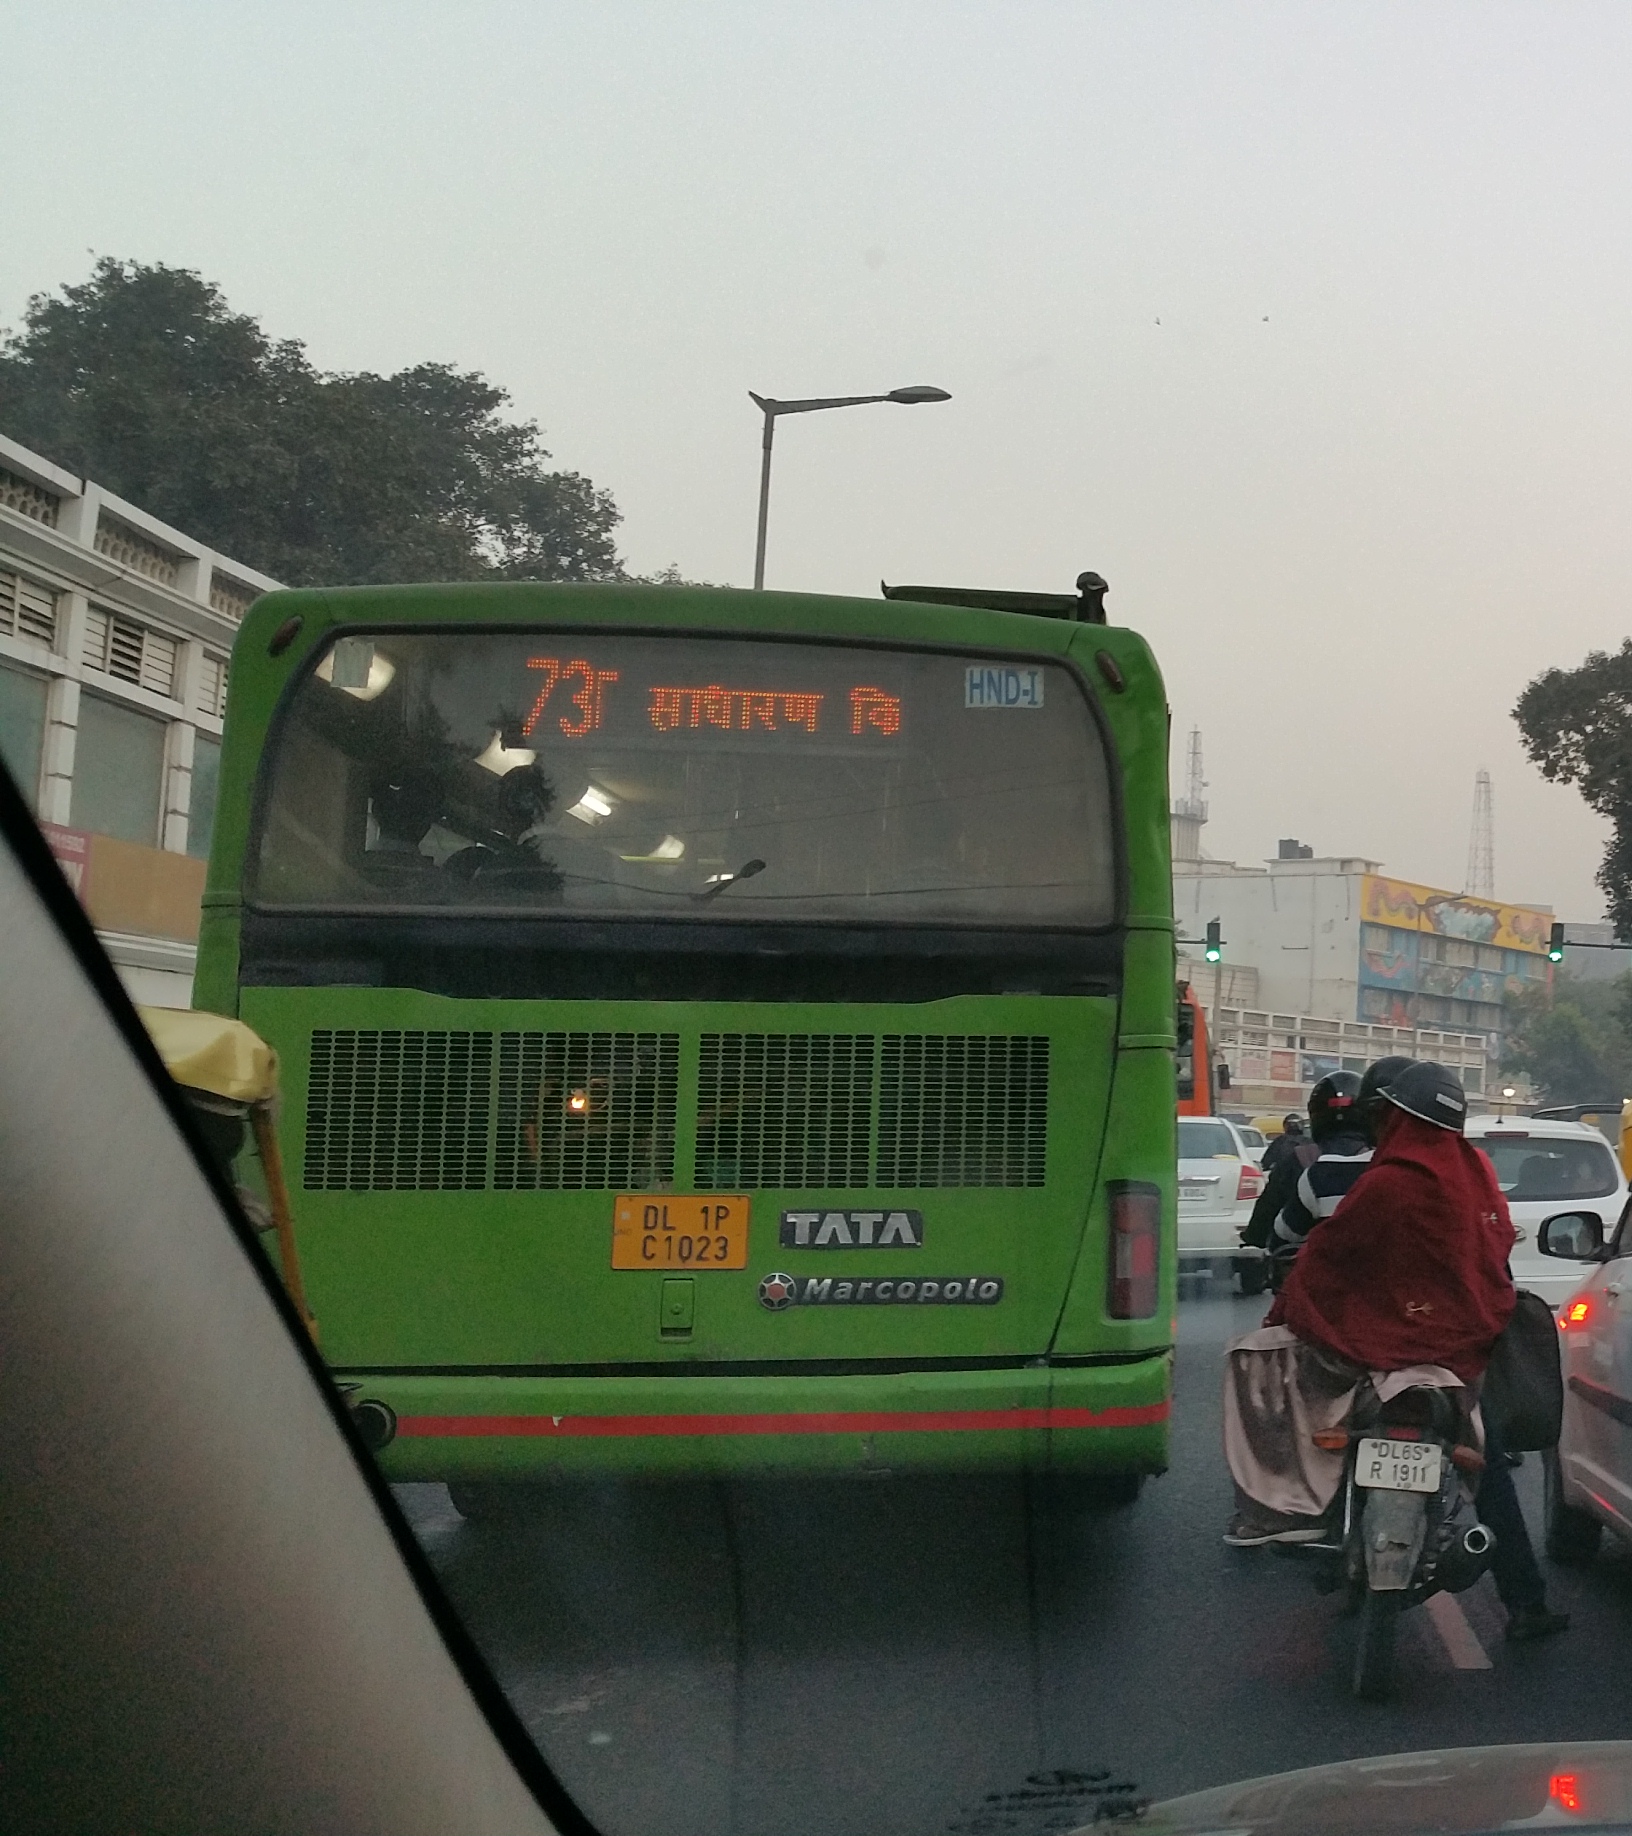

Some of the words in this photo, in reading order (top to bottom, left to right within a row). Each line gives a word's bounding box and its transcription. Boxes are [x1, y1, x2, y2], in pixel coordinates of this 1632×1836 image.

[969, 669, 1039, 705] HND-I
[643, 1204, 677, 1231] DL
[700, 1204, 730, 1231] 1P
[786, 1213, 918, 1245] TATA
[642, 1234, 729, 1262] C1023
[803, 1278, 999, 1302] Marcopolo
[1378, 1442, 1422, 1461] DL6S
[1370, 1461, 1383, 1480] R
[1392, 1463, 1426, 1484] 1911
